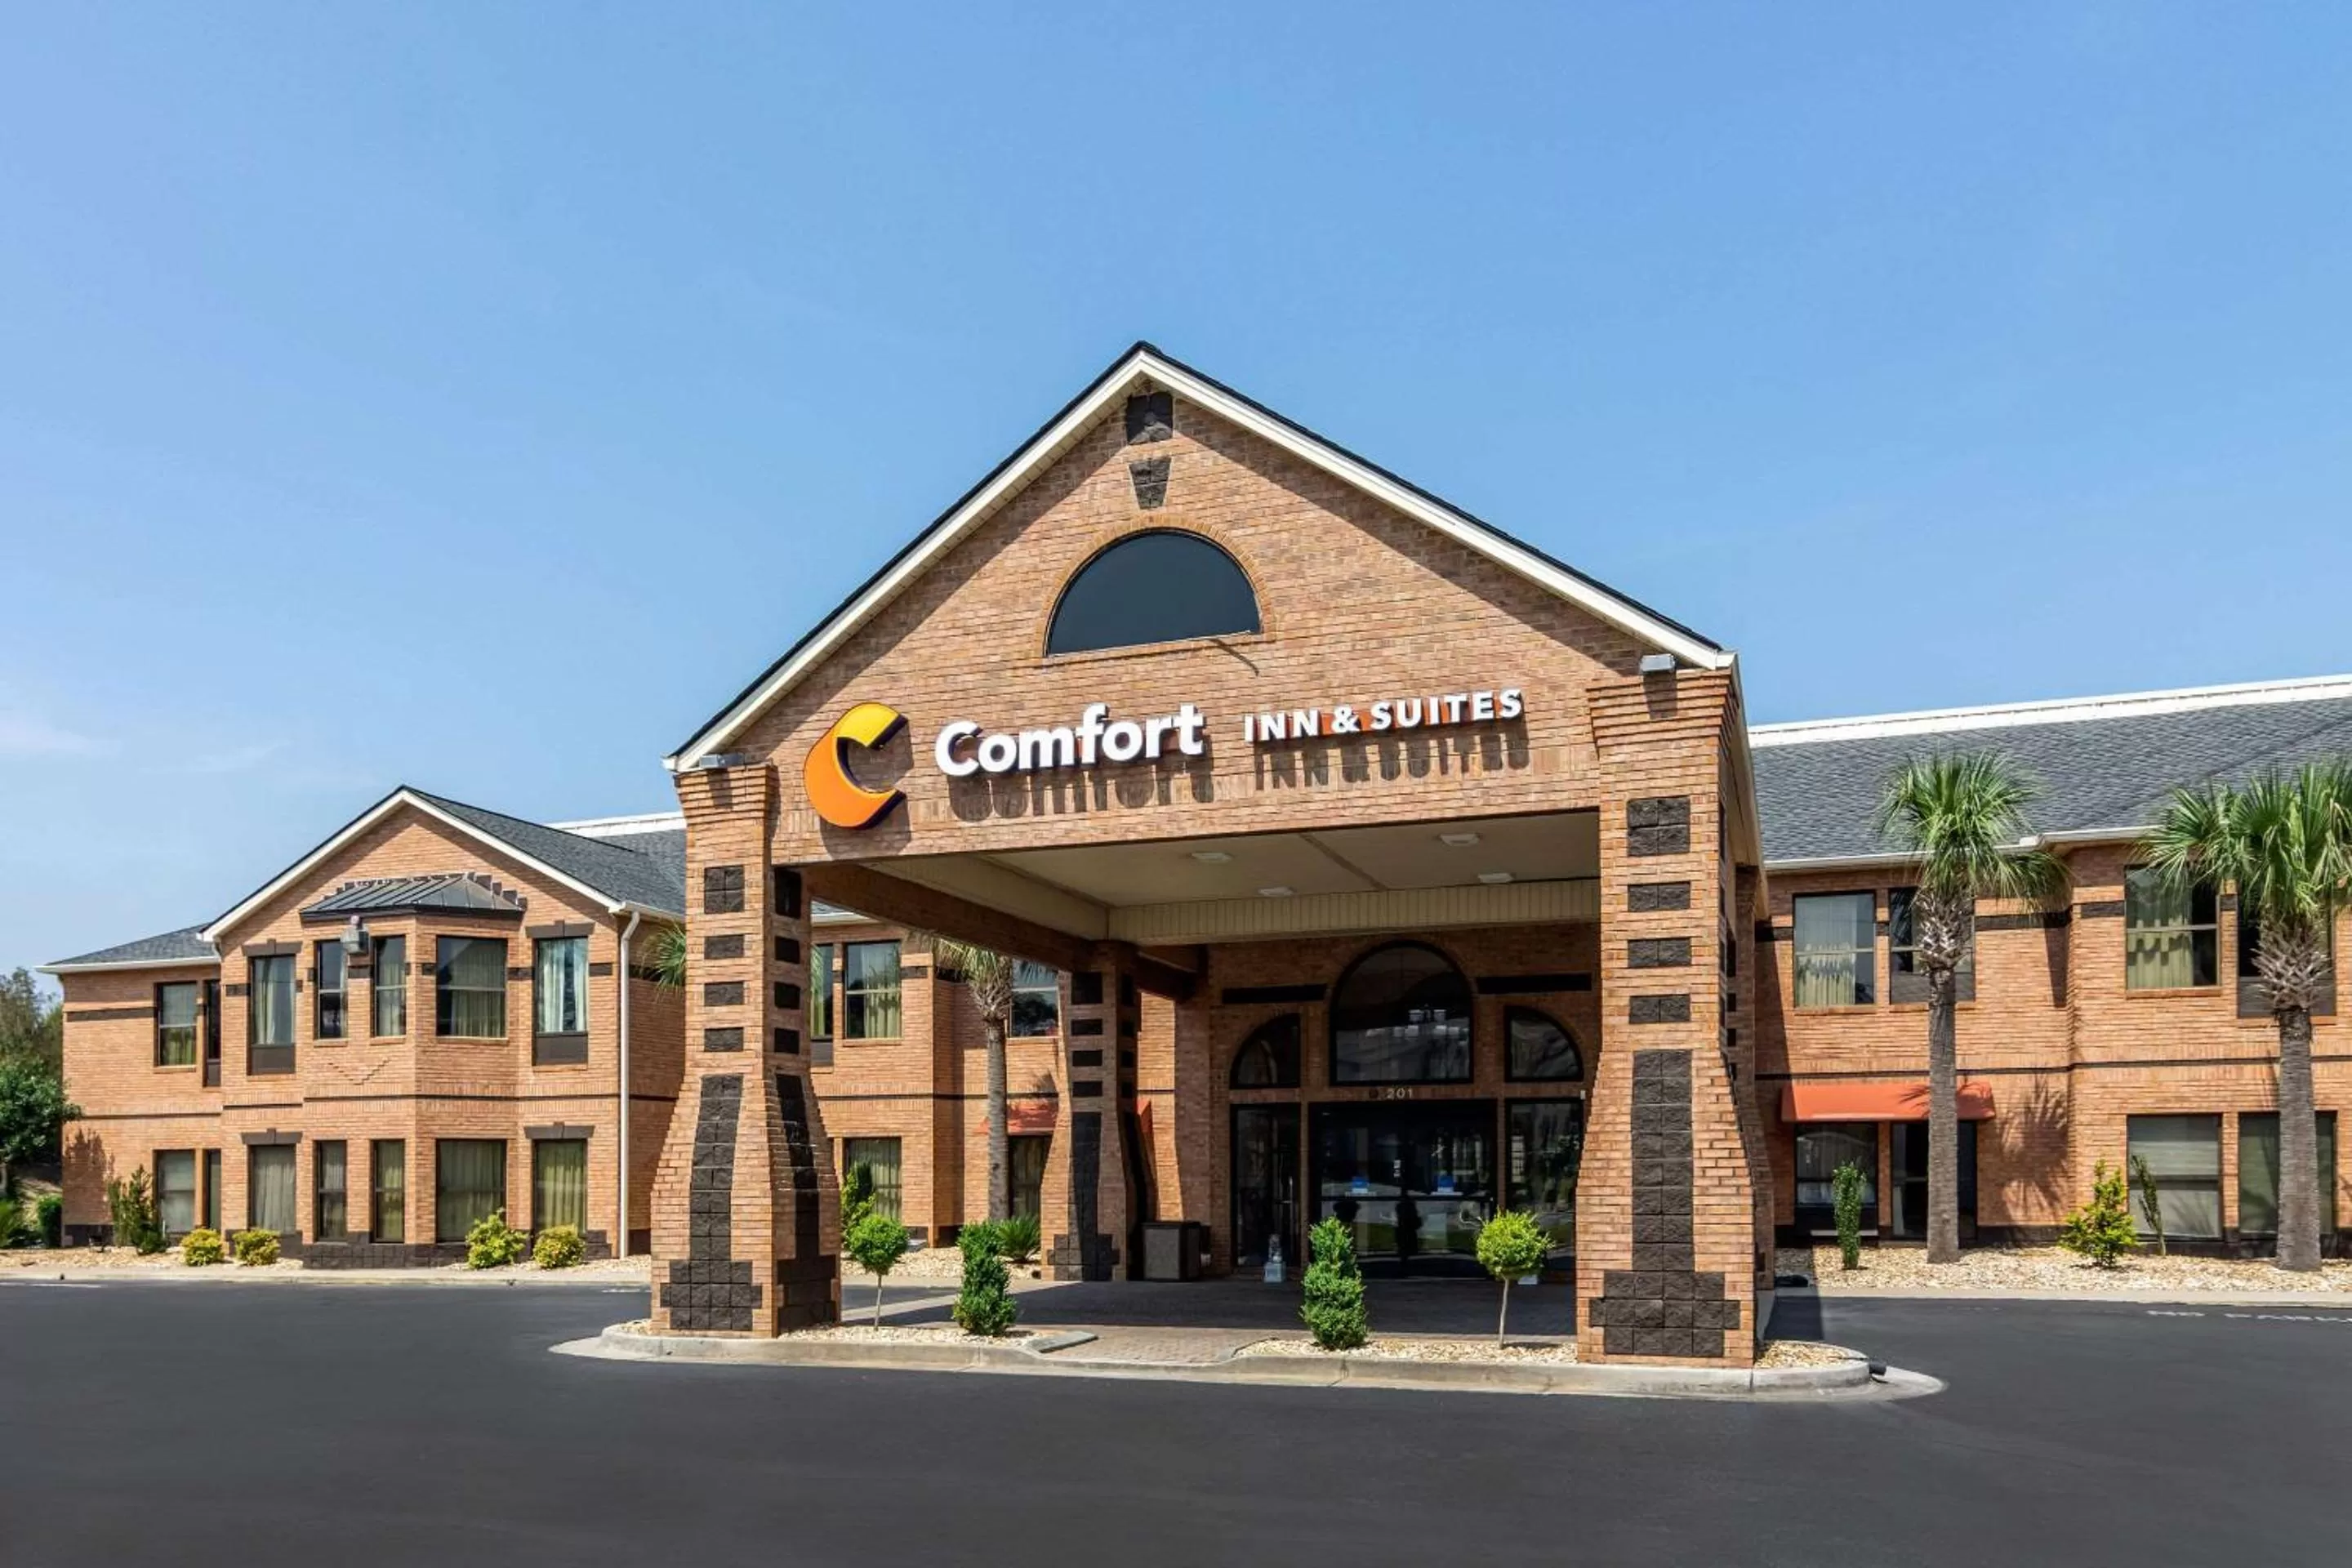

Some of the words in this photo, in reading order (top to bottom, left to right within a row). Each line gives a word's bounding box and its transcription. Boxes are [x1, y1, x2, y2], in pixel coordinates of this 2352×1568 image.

[935, 702, 1205, 777] Comfort
[1244, 709, 1320, 742] INN
[1331, 704, 1361, 734] &
[1370, 688, 1522, 731] SUITES
[1387, 1087, 1413, 1100] 201
